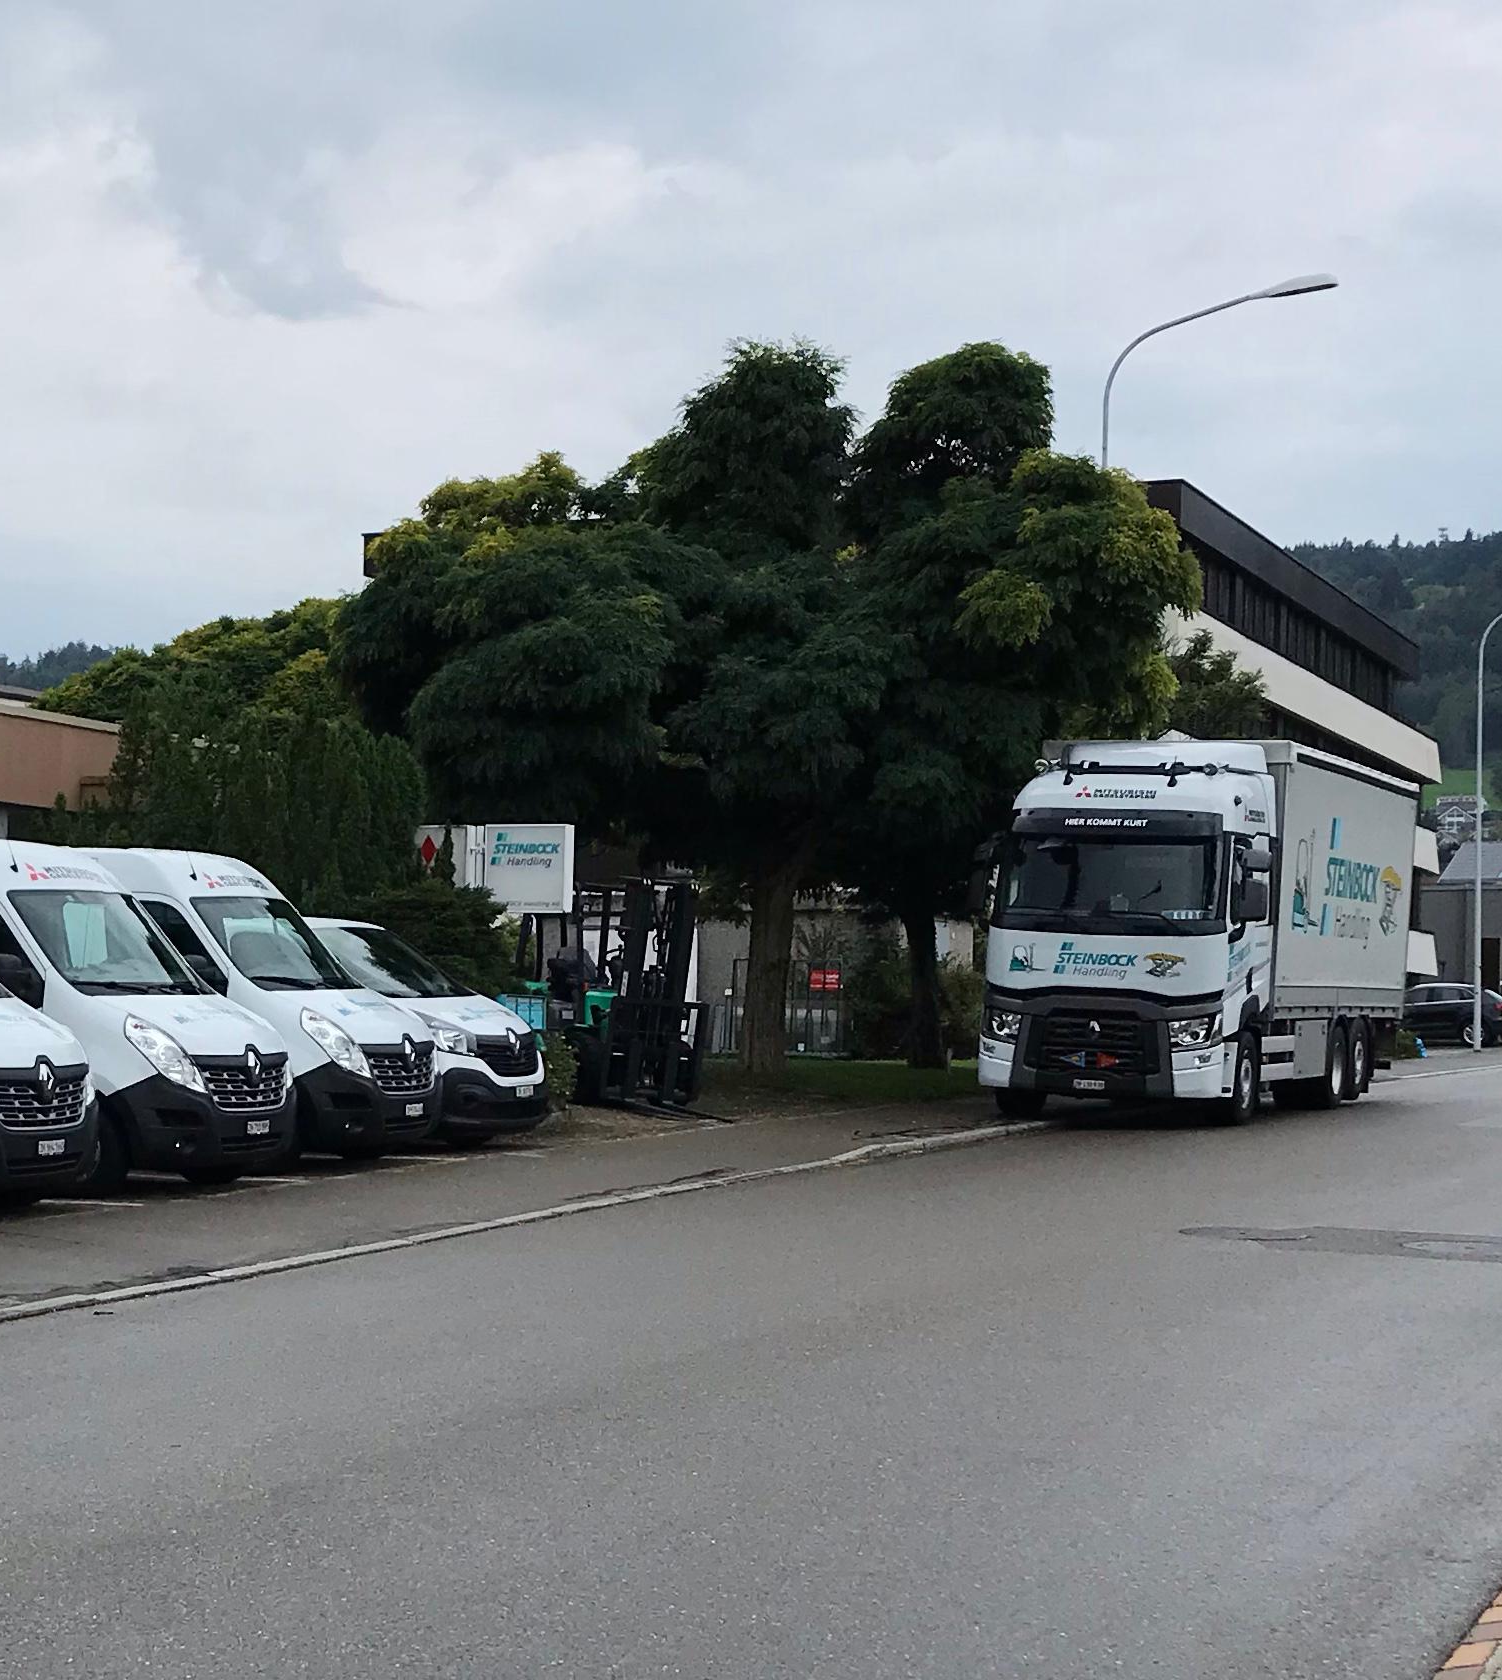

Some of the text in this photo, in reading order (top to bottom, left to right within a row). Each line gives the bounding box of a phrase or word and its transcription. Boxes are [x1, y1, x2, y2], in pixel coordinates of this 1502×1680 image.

[1064, 818, 1148, 827] HIER KOMMT KURT
[493, 843, 561, 855] STEINBOCK
[506, 856, 552, 868] Handling
[1324, 857, 1381, 904] STEINBOCK
[1056, 952, 1138, 967] STEINBOCK
[1073, 966, 1128, 980] Handling
